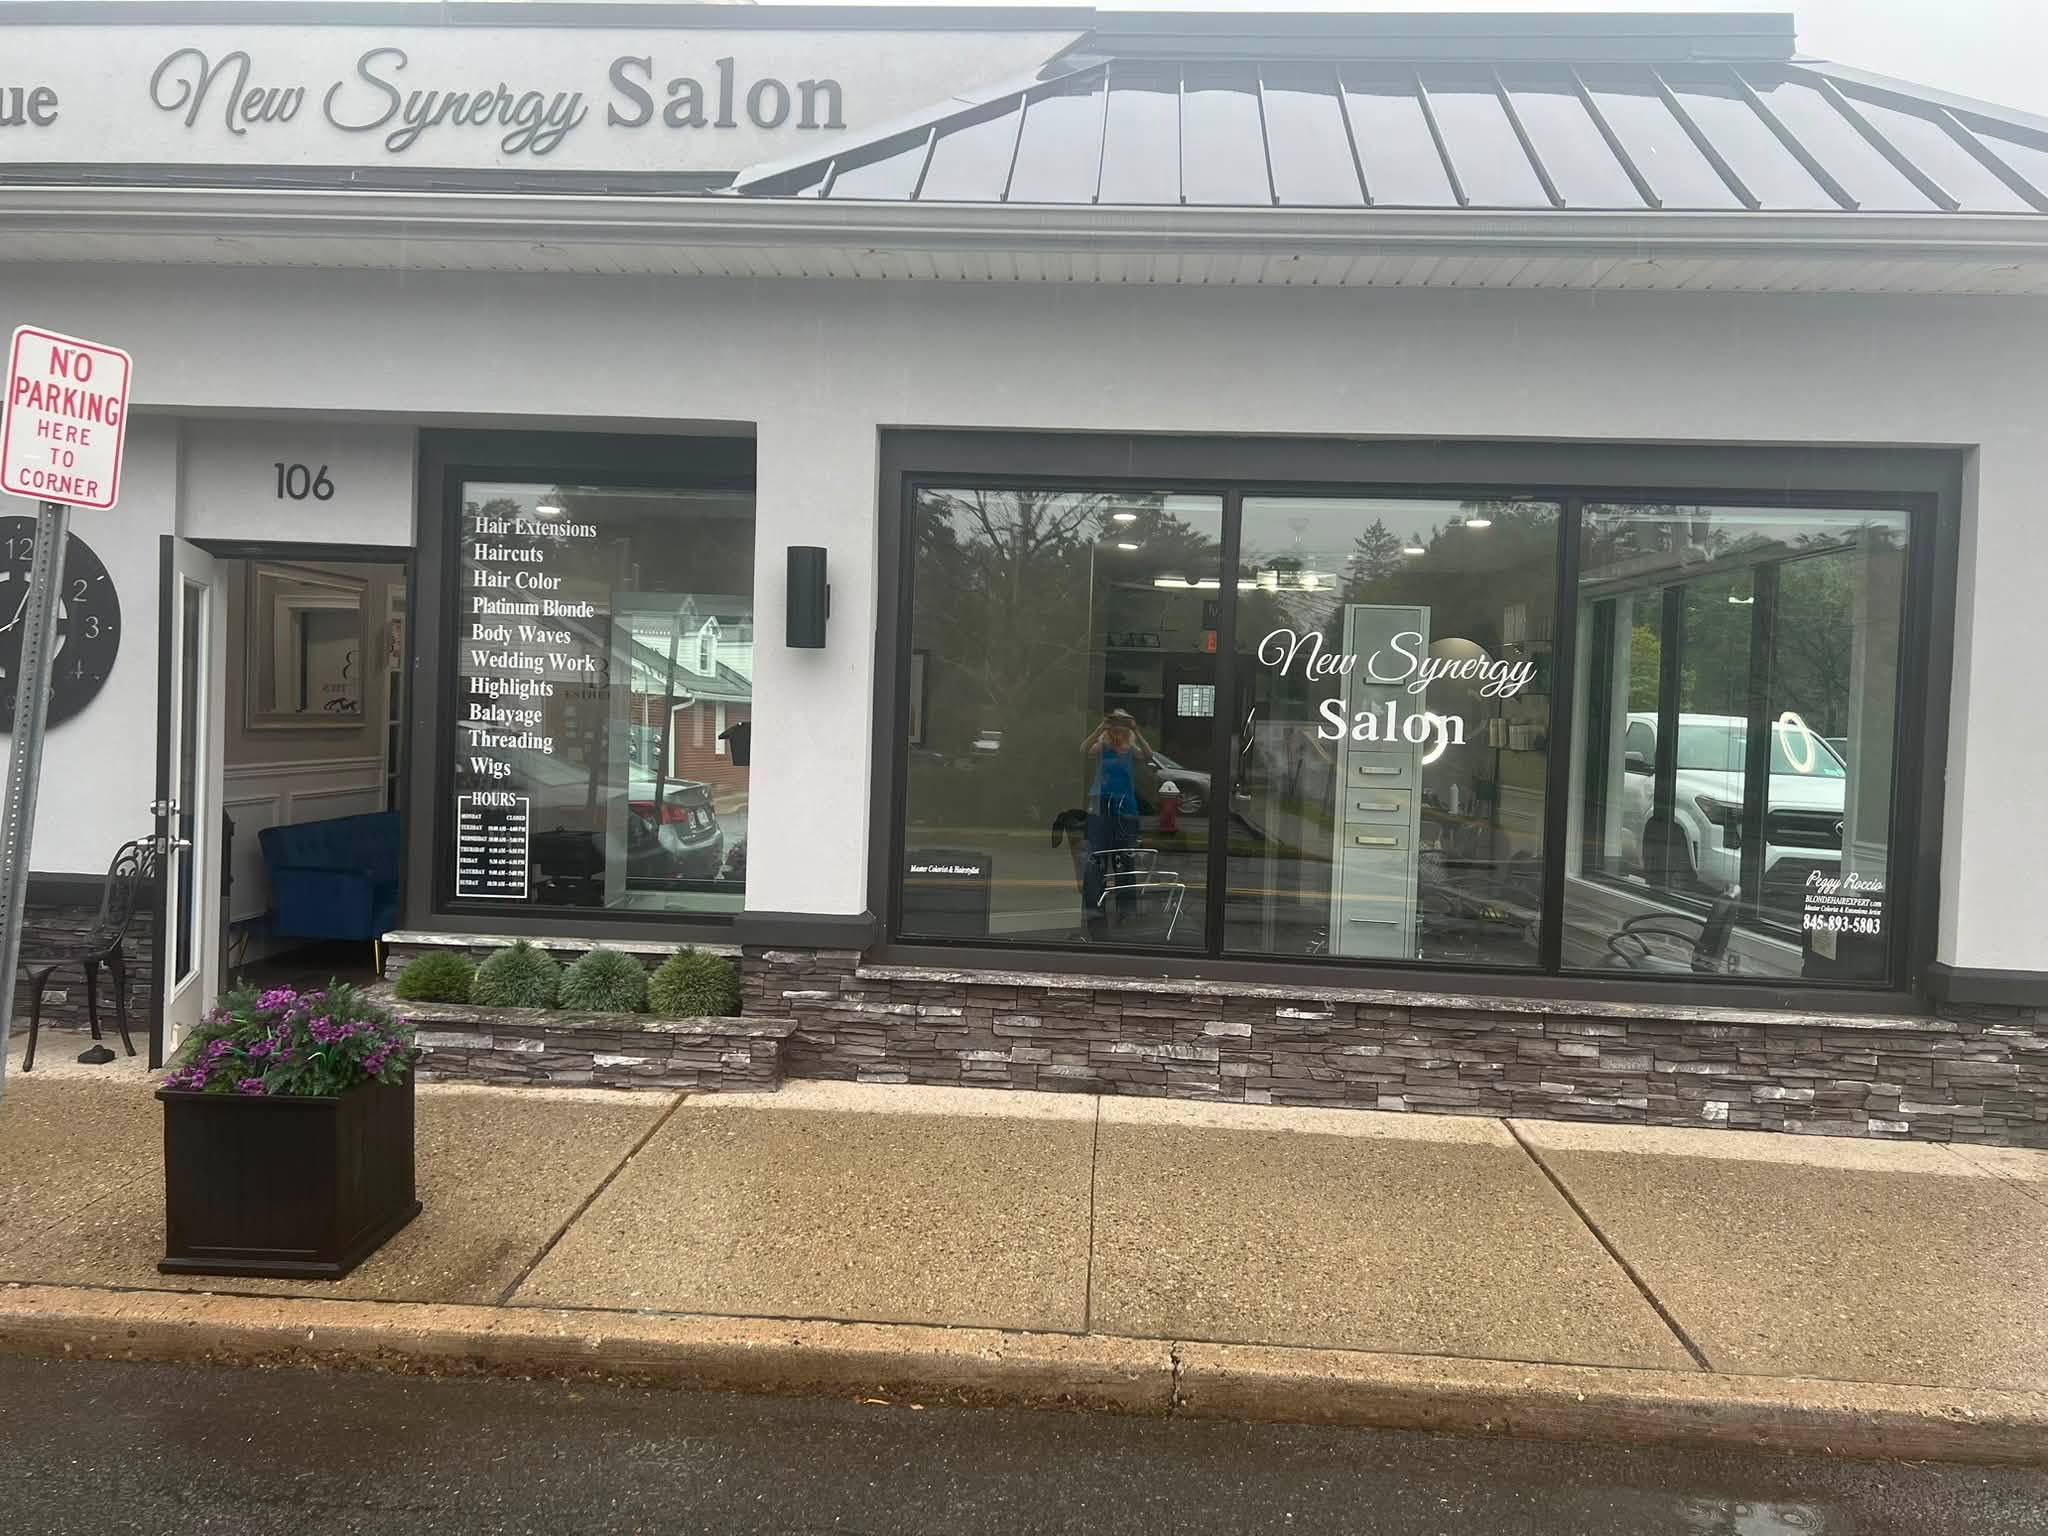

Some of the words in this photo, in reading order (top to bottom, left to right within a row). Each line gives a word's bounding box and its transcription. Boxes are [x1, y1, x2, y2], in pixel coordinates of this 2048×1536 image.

[150, 48, 304, 134] New
[323, 48, 588, 154] Synergy
[607, 54, 846, 131] Salon
[50, 346, 92, 382] NO
[15, 376, 119, 427] PARKING
[37, 419, 91, 446] HERE
[50, 448, 74, 468] TO
[20, 468, 98, 498] CORNER
[274, 463, 335, 501] 106
[475, 516, 511, 534] Hair
[515, 518, 597, 538] Extensions
[5, 538, 33, 560] 12
[474, 543, 544, 562] Haircuts
[72, 579, 88, 602] 2
[473, 570, 511, 588] Hair
[515, 571, 561, 590] Color
[472, 597, 539, 616] Platinum
[543, 599, 594, 618] Blonde
[85, 616, 99, 639] 3
[472, 623, 512, 646] Body
[518, 625, 571, 644] Waves
[472, 650, 544, 674] Wedding
[549, 653, 596, 672] Work
[1258, 629, 1356, 682] New
[1368, 631, 1537, 698] Synergy
[470, 677, 553, 700] Highlights
[469, 703, 543, 727] Balayage
[1317, 698, 1466, 746] Salon
[469, 730, 553, 754] Threading
[470, 757, 511, 780] Wigs
[472, 791, 516, 806] HOURS
[1806, 870, 1841, 894] Peggy
[1843, 872, 1883, 891] Roccio
[1803, 914, 1880, 934] 845-893-5803
